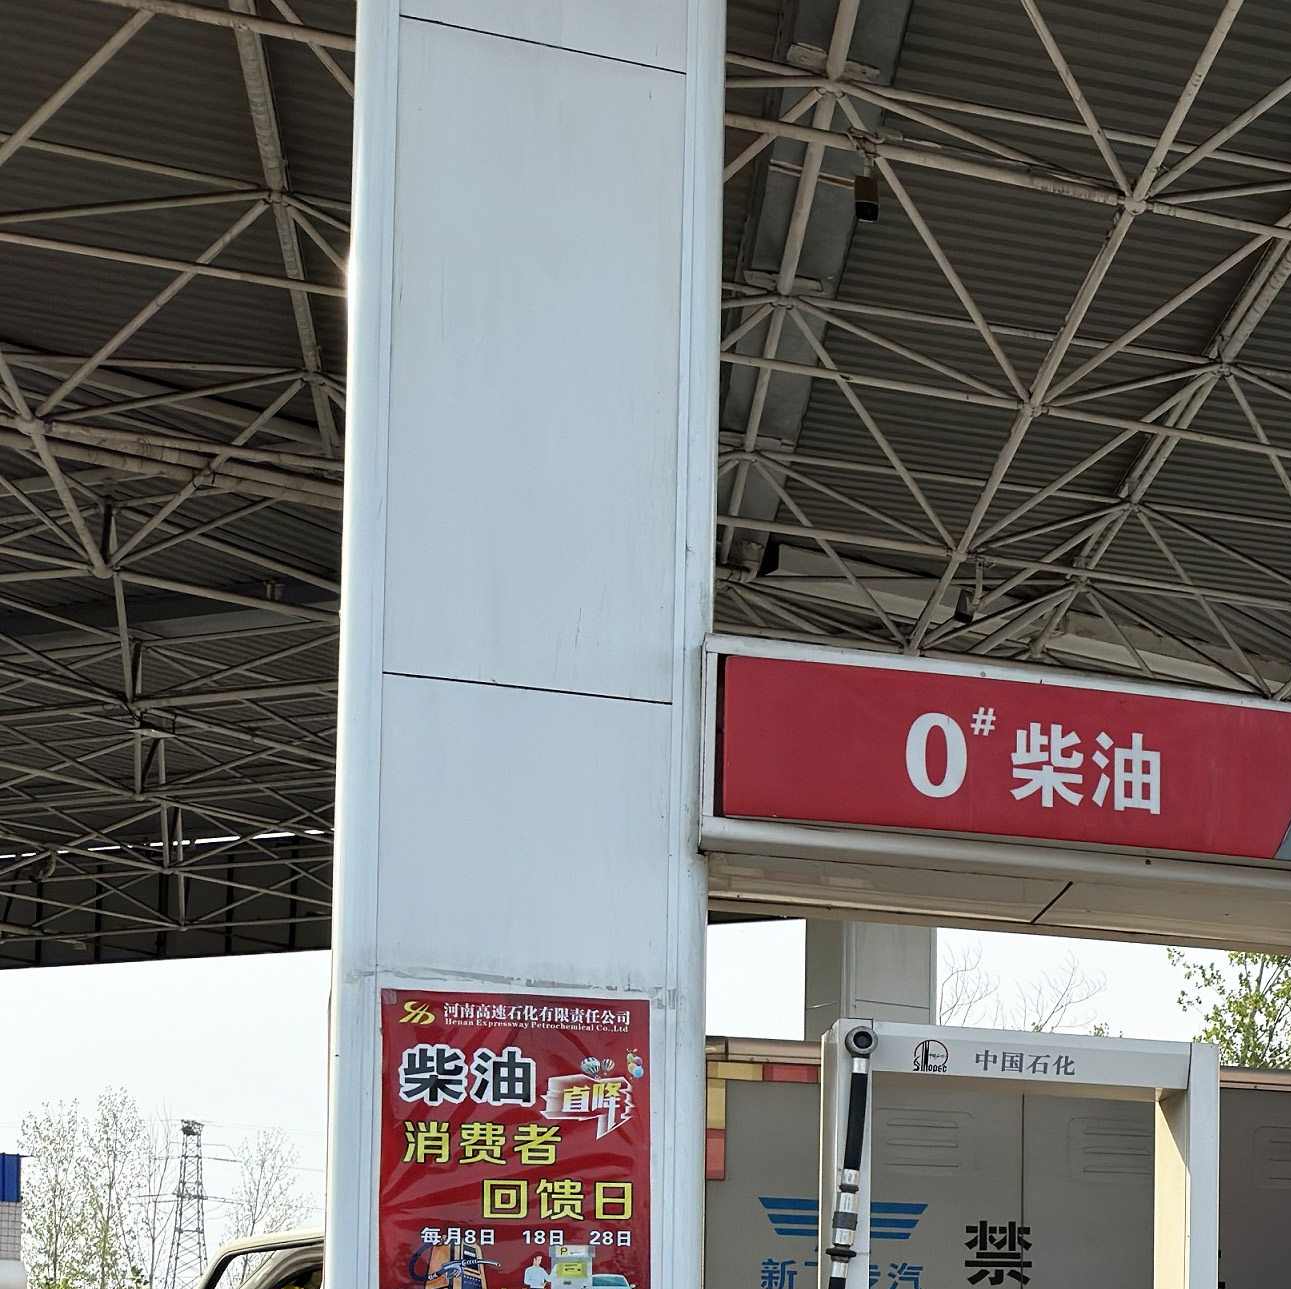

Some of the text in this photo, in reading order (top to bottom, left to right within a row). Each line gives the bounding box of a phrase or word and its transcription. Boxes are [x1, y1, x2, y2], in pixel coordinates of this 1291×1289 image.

[905, 706, 1161, 815] 0# 柴油
[444, 1002, 631, 1026] 河南高速石化有限责任公司
[445, 1018, 474, 1026] Henan
[476, 1019, 529, 1029] Expressway
[531, 1021, 594, 1032] Petrochemical
[400, 1046, 535, 1104] 柴油
[975, 1049, 1075, 1076] 中国石化
[562, 1081, 623, 1134] 直降
[402, 1121, 562, 1165] 消费者
[481, 1178, 634, 1221] 回馈日
[421, 1226, 631, 1247] 每月8日 18日 28日
[965, 1220, 1032, 1286] 禁
